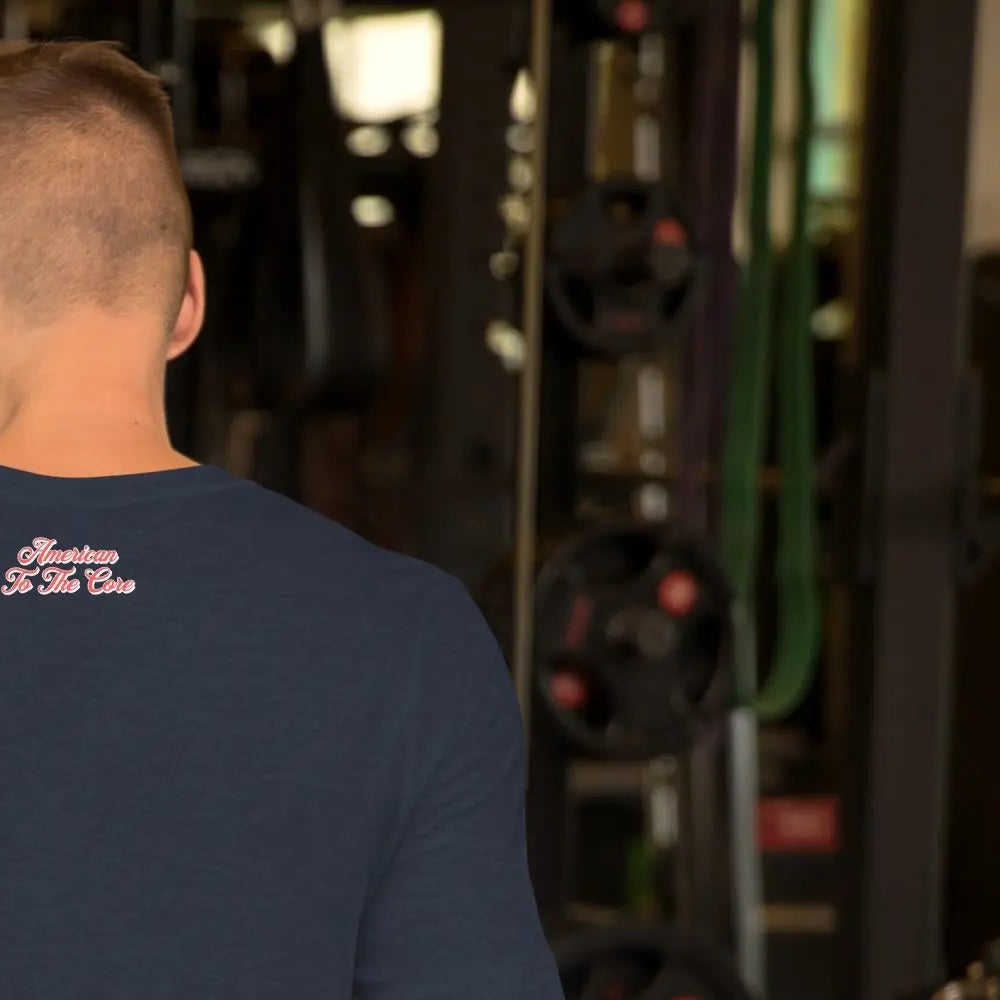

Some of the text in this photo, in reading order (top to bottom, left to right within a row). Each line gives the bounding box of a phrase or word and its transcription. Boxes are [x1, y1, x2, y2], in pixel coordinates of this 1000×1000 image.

[17, 537, 119, 566] American
[1, 566, 136, 595] To The Core
